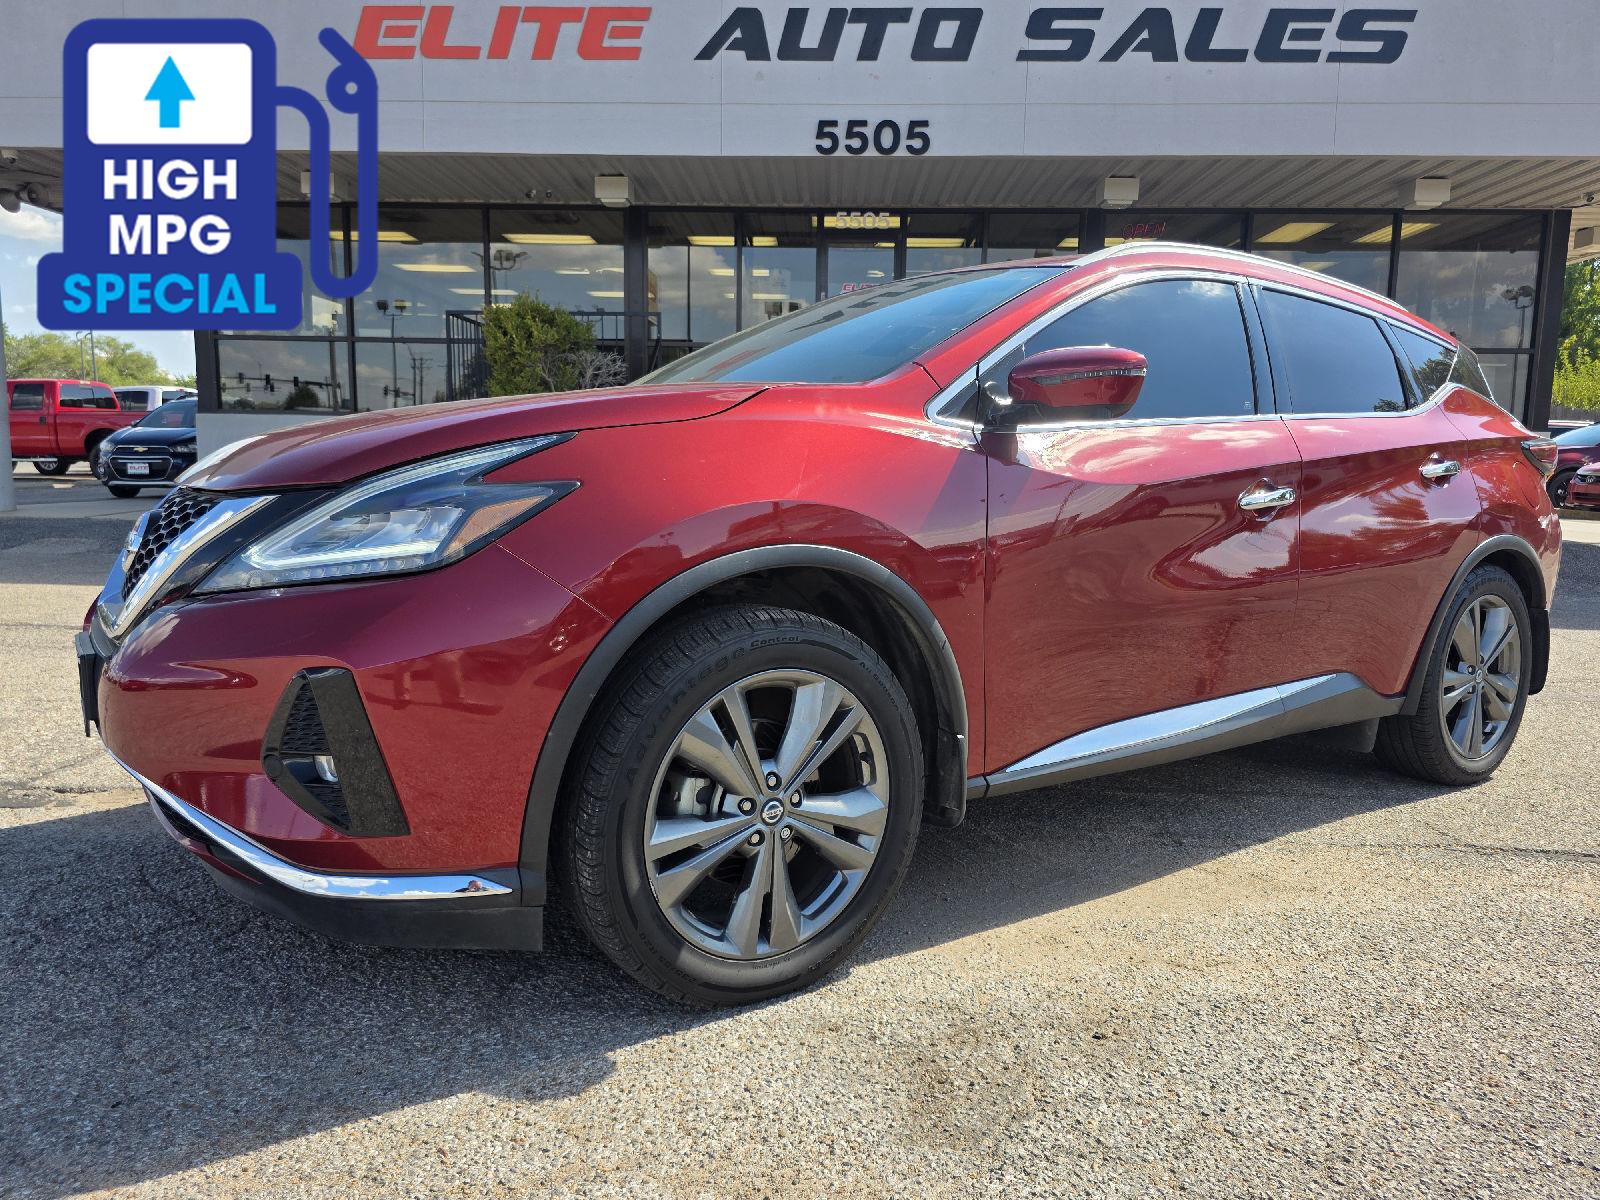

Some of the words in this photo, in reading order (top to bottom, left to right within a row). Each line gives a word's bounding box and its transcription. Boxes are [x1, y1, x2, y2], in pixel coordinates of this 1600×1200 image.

[354, 6, 651, 60] ELITE
[694, 7, 983, 62] AUTO
[1016, 8, 1418, 63] SALES
[815, 119, 931, 155] 5505
[835, 211, 890, 229] 5505
[750, 635, 800, 649] Control
